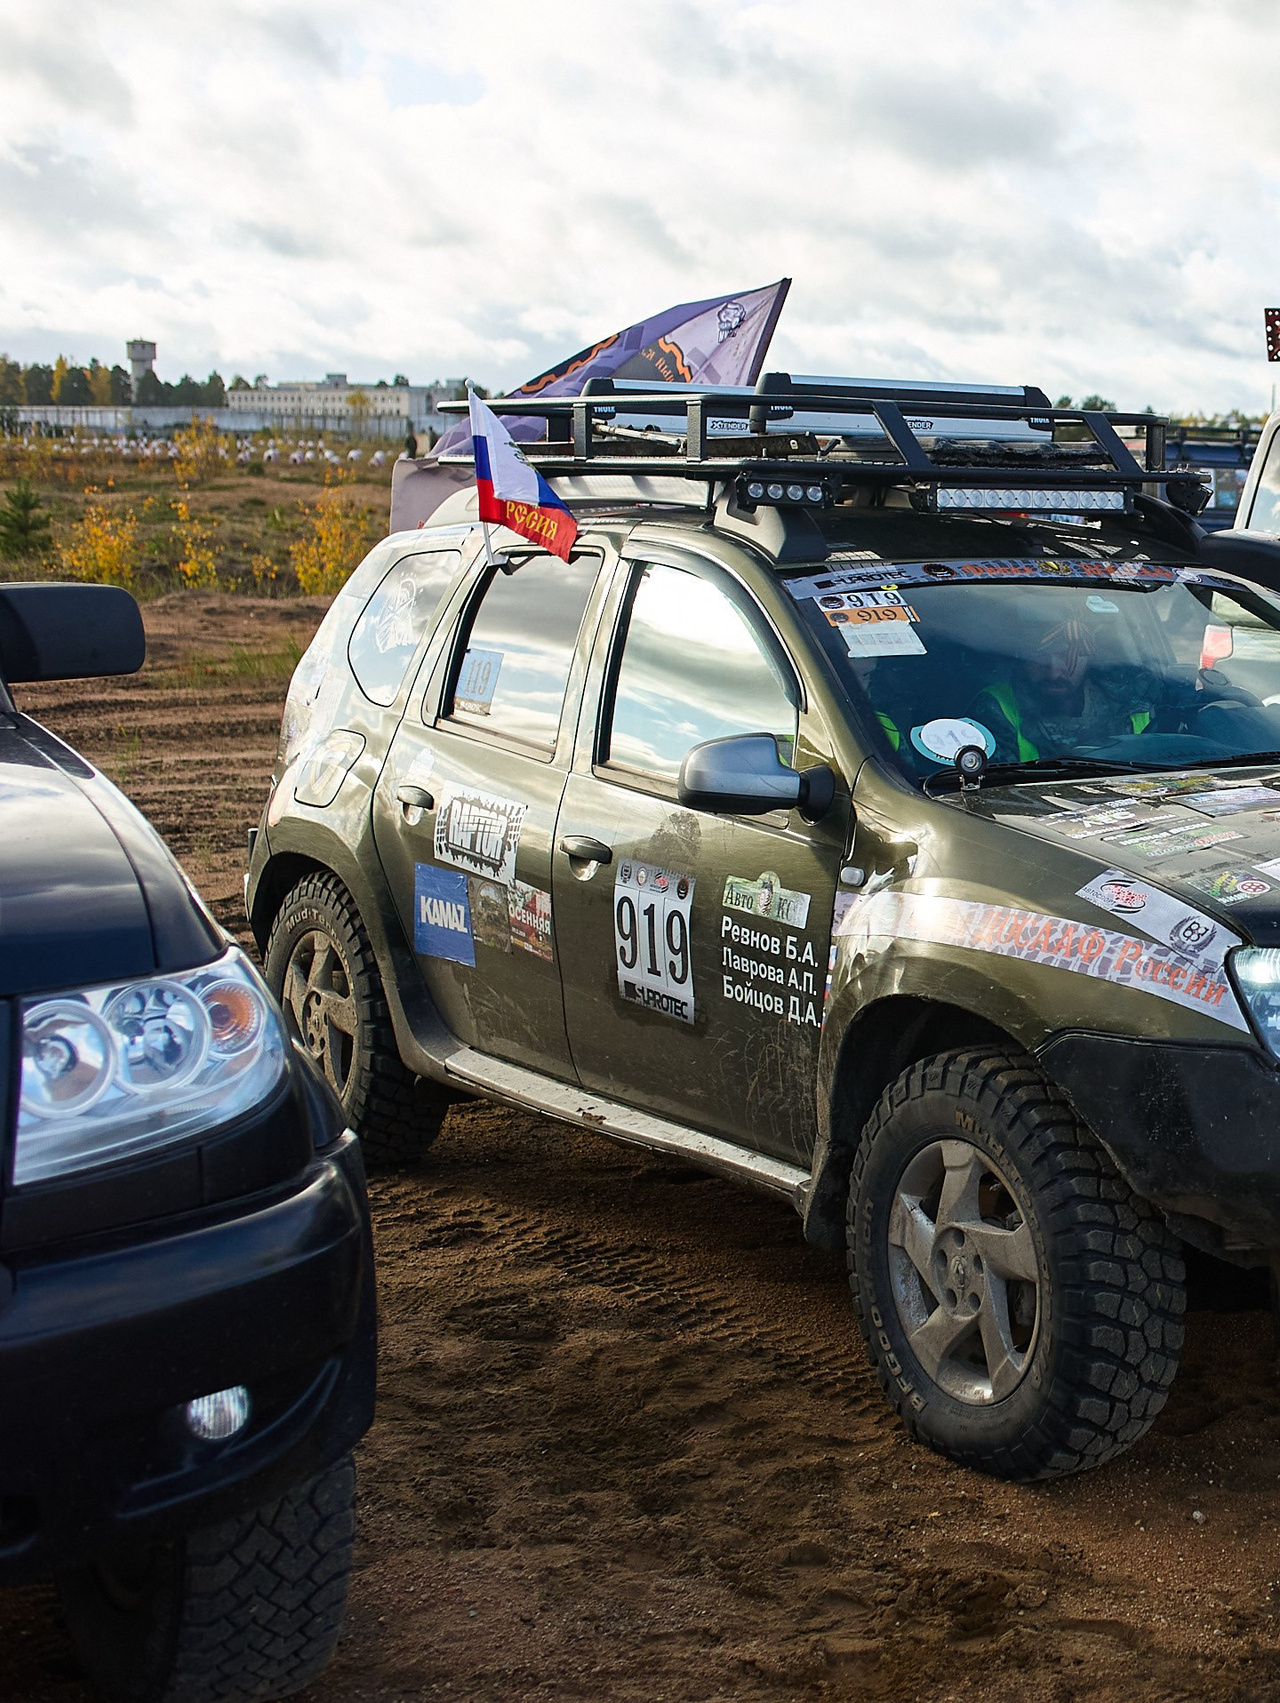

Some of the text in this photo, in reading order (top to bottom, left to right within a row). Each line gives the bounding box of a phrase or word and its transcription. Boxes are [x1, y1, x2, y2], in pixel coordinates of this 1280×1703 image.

[846, 592, 901, 608] 919
[857, 608, 898, 622] 919
[448, 799, 509, 861] RAPTOR
[420, 895, 469, 934] KAMAZ
[508, 904, 551, 936] ОСЕННЯЯ
[616, 895, 689, 985] 919
[721, 915, 819, 968] Ревнов Б.А.
[971, 908, 1228, 1007] ДОСААФ России
[722, 946, 817, 996] Лаврова А.П.
[633, 982, 689, 1020] SUPROTEC
[722, 974, 822, 1028] Бойцов Д.А.
